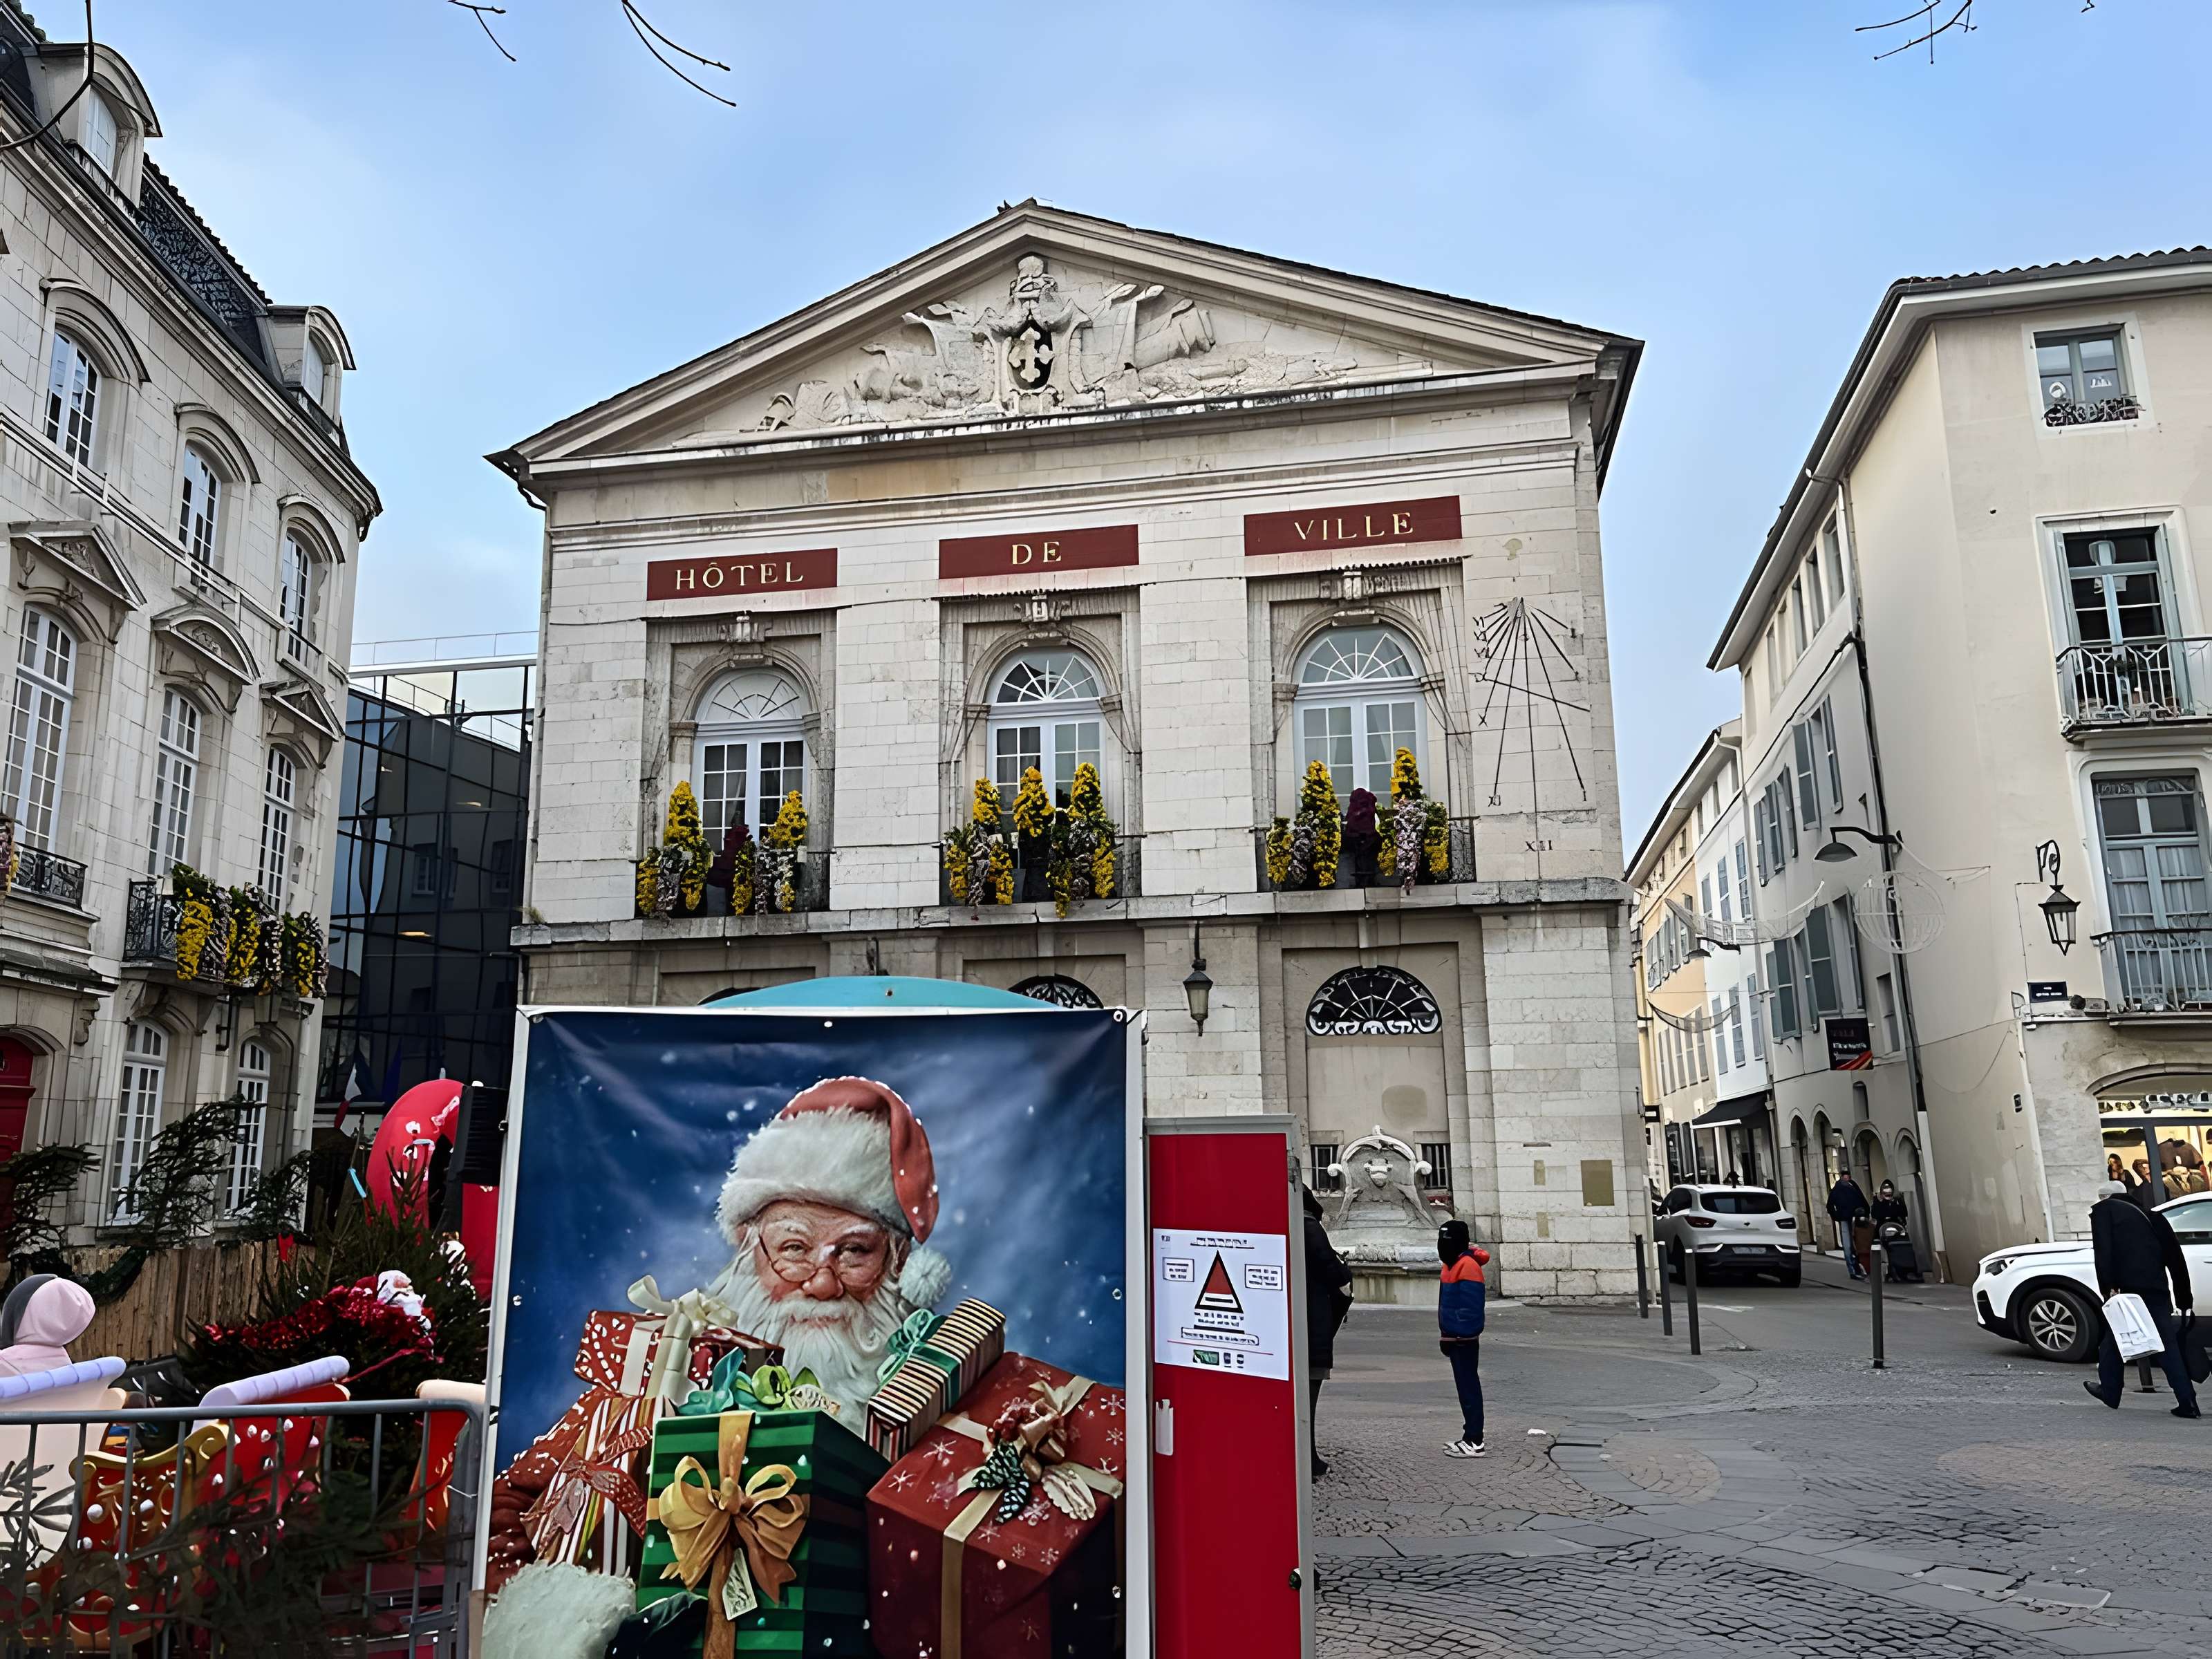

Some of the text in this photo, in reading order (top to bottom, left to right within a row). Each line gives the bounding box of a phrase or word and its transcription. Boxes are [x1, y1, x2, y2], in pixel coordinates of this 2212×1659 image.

[676, 512, 1414, 590] HÔTEL DE VILLE
[1525, 840, 1553, 852] XII
